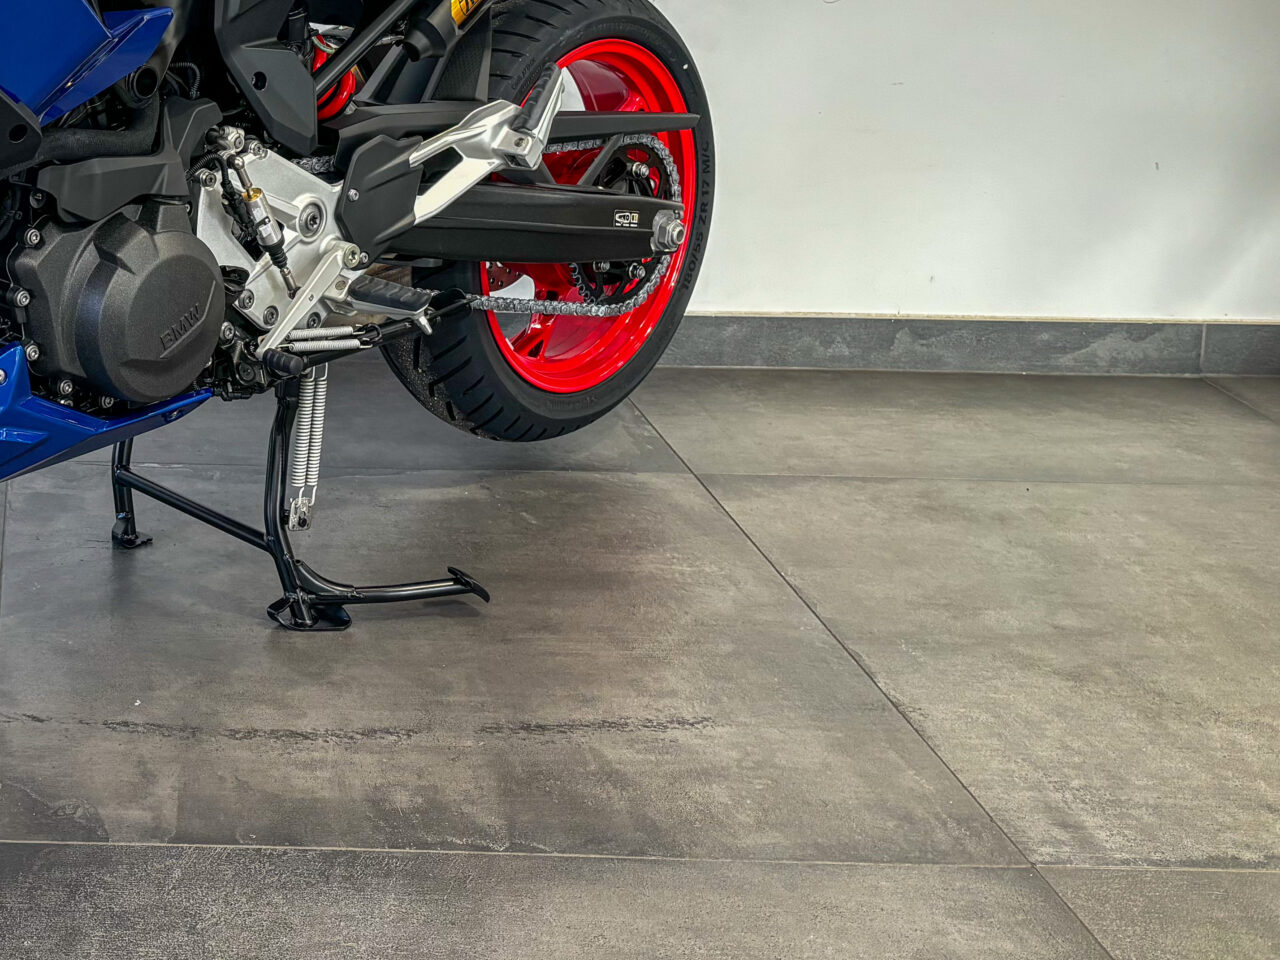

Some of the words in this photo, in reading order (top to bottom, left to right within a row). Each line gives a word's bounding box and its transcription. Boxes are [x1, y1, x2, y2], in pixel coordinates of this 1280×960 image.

[701, 181, 711, 195] 17
[697, 201, 709, 226] ZR
[678, 231, 704, 291] 180/55
[160, 302, 200, 351] BMW
